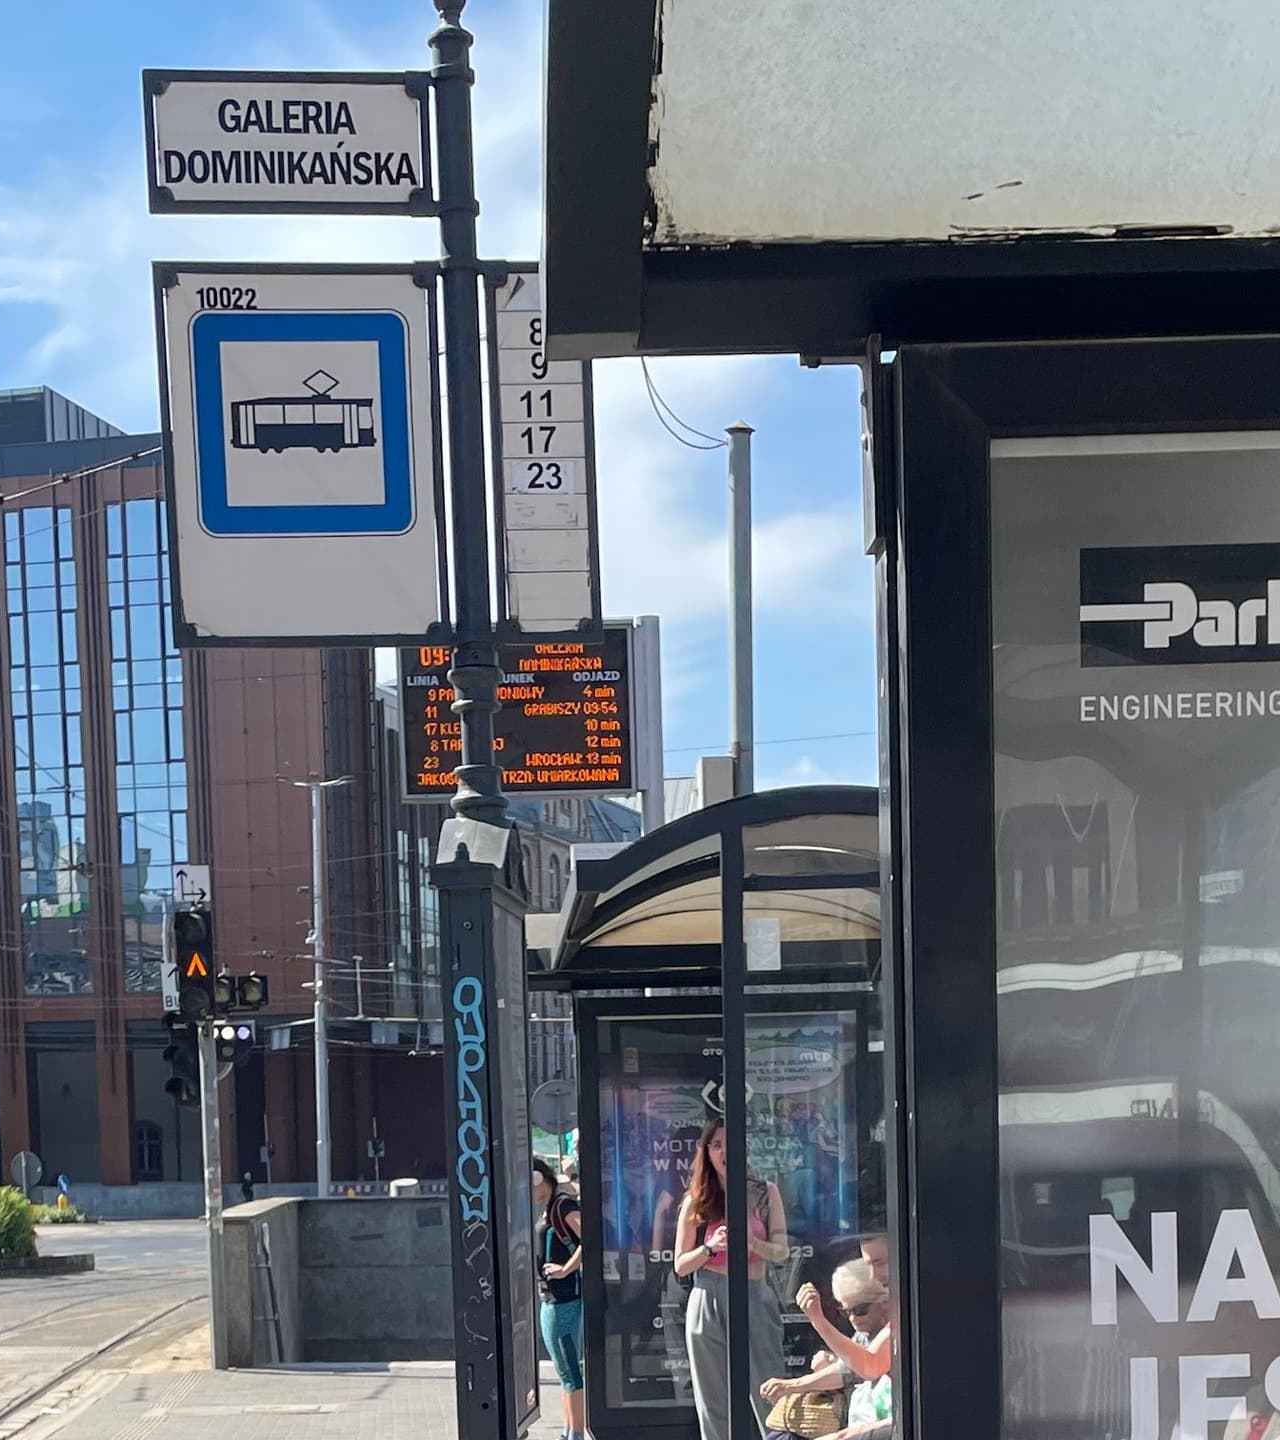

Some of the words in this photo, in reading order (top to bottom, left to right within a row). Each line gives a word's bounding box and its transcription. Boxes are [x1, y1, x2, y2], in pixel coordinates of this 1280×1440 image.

[218, 99, 356, 135] GALERIA
[164, 142, 417, 186] DOMINIKAŃSKA
[196, 287, 257, 311] 10022
[529, 318, 542, 346] 8
[531, 352, 548, 379] 9
[520, 389, 552, 418] 11
[521, 426, 556, 455] 17
[527, 462, 562, 490] 23
[406, 675, 439, 686] LINIA
[572, 671, 620, 682] ODJAZD
[428, 689, 437, 702] 9
[594, 685, 615, 698] min
[424, 705, 438, 719] 11
[423, 723, 438, 736] 17
[600, 719, 621, 731] min
[585, 736, 599, 748] 12
[601, 734, 621, 748] min
[423, 756, 440, 769] 23
[601, 752, 622, 765] min
